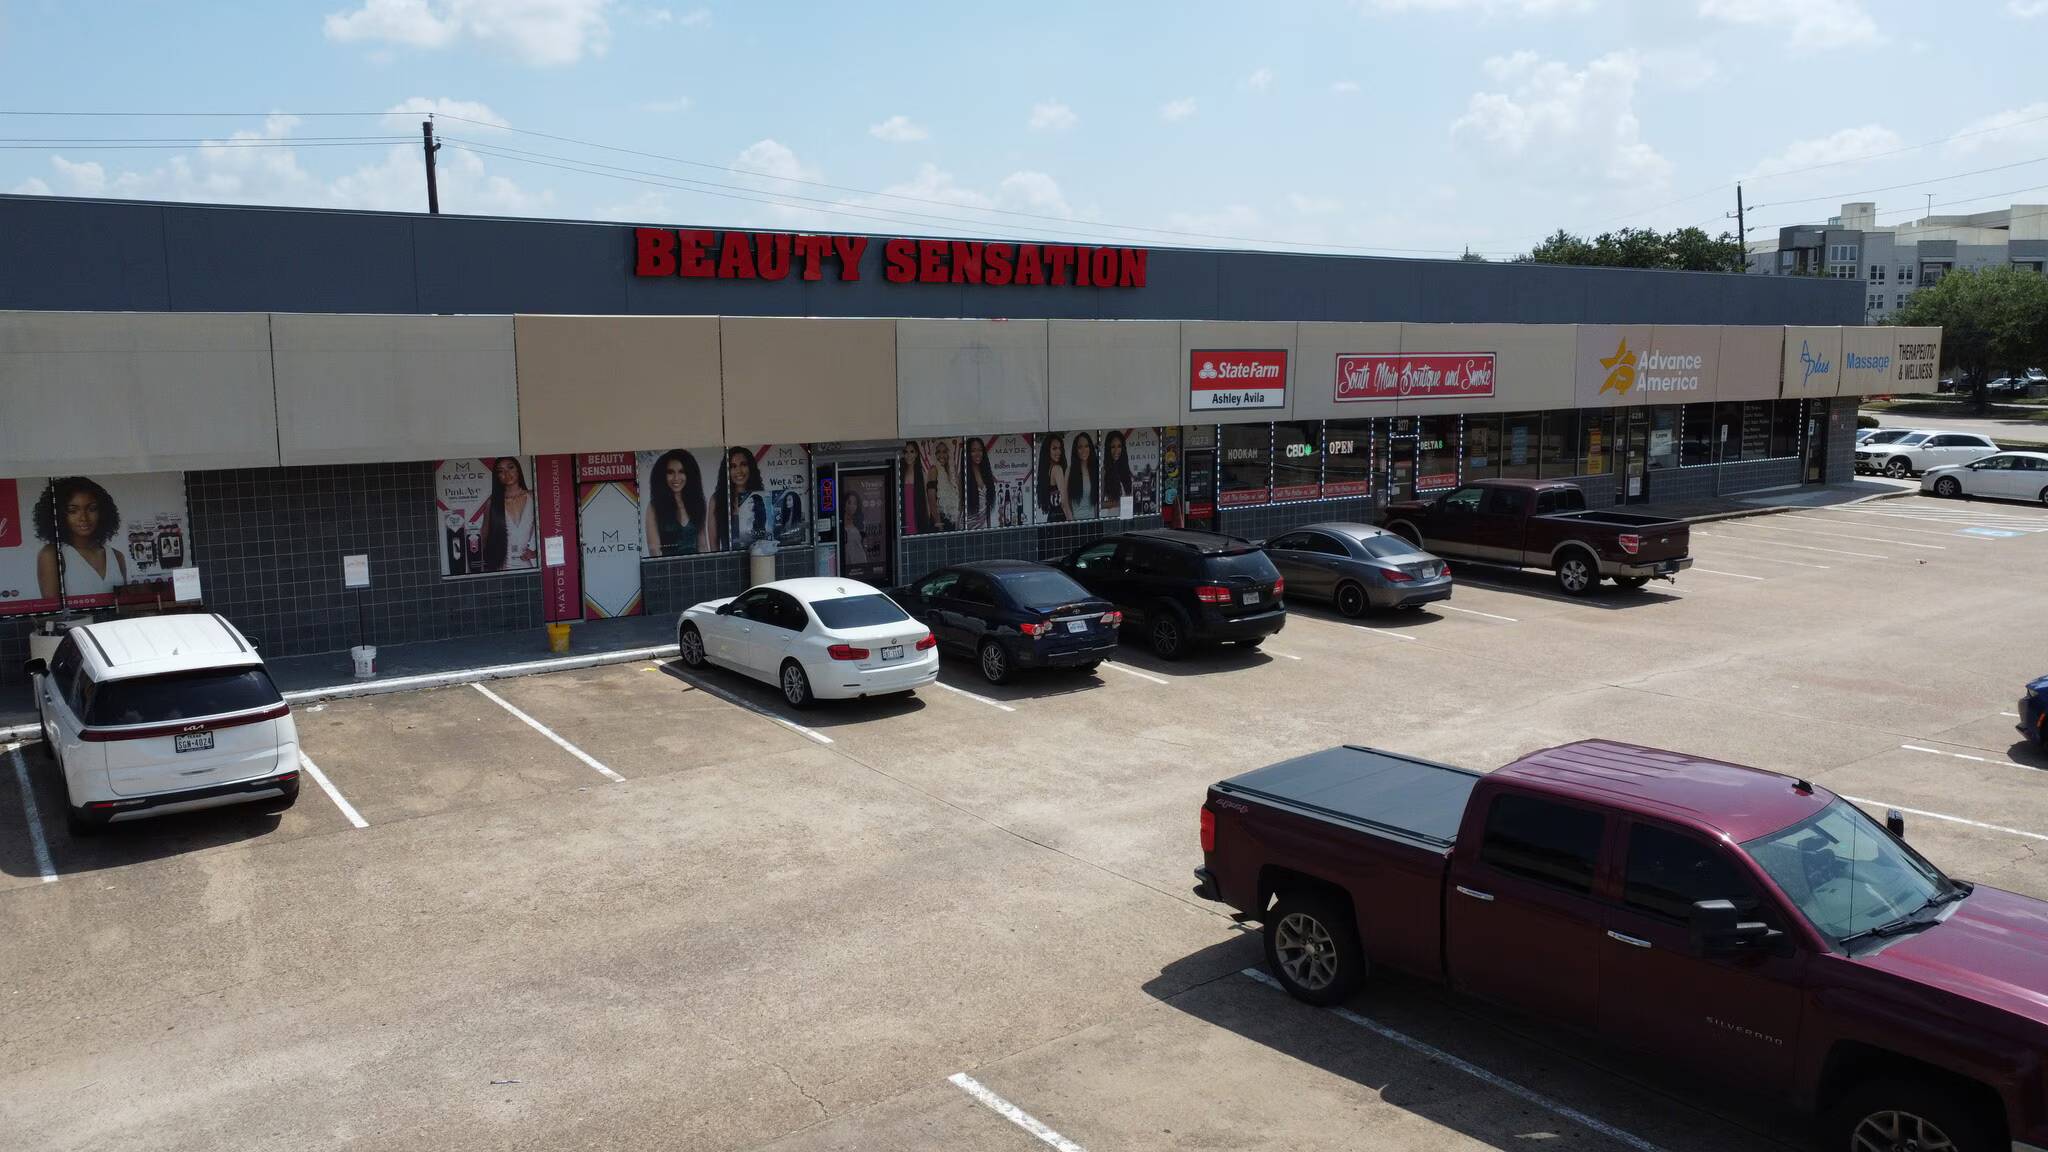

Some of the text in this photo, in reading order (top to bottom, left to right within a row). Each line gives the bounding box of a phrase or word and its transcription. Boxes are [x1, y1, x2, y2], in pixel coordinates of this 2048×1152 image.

[634, 228, 1148, 288] BEAUTY SENSATION
[1637, 350, 1702, 370] Advance
[1898, 343, 1937, 361] THERAPEUTIC
[1846, 352, 1889, 373] Massage
[1904, 361, 1934, 380] WELLNESS
[1341, 359, 1492, 395] South Main Boutique and Smoke
[1635, 370, 1699, 393] America
[1211, 391, 1265, 406] Ashley Avila
[1228, 448, 1258, 460] HOOKAH
[1286, 443, 1304, 458] CBD
[1328, 440, 1354, 455] OPEN
[588, 453, 624, 464] BEAUTY
[767, 458, 808, 467] MAYDE
[442, 472, 485, 481] MAYDE
[581, 464, 632, 477] SENSATION
[769, 478, 786, 487] Wet
[823, 479, 833, 512] OPEN
[551, 484, 561, 527] AUTHORIZED
[557, 569, 566, 614] MAYDE
[1705, 1015, 1783, 1046] SILVERADO
